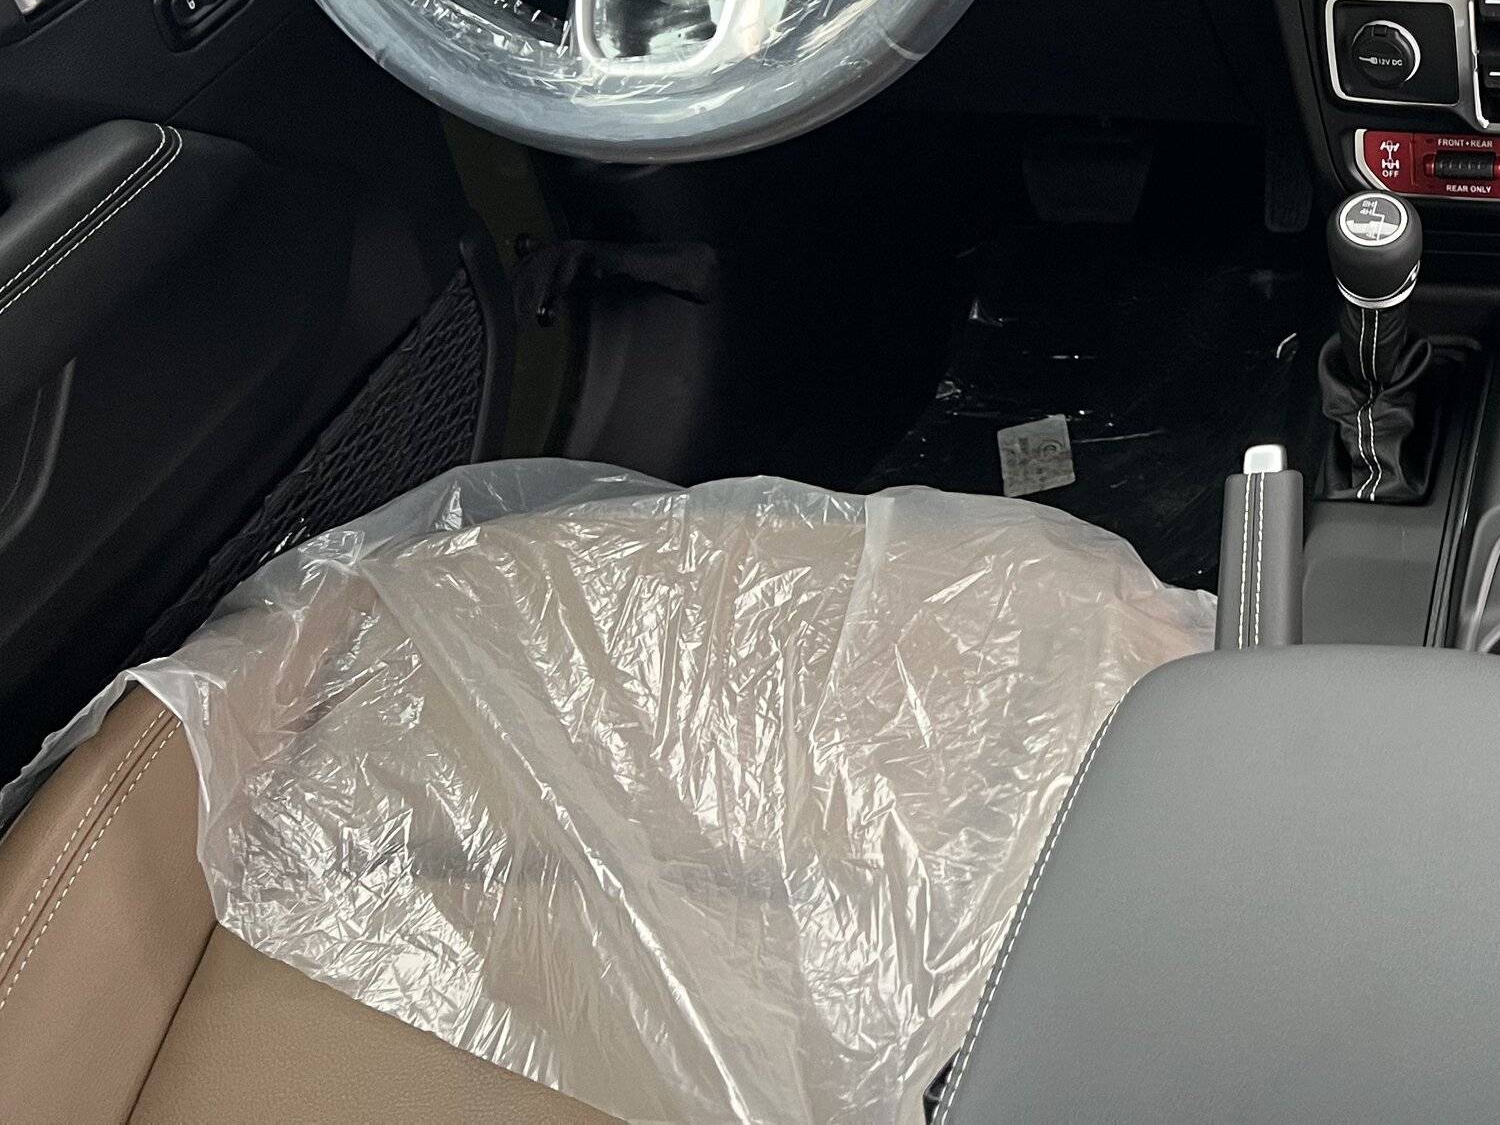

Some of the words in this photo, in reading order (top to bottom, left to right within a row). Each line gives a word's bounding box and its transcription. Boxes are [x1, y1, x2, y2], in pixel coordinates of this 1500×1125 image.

[1378, 58, 1390, 66] 12V
[1391, 59, 1403, 67] DC
[1382, 170, 1400, 178] OFF
[1446, 184, 1469, 193] REAR
[1470, 185, 1492, 194] ONLY
